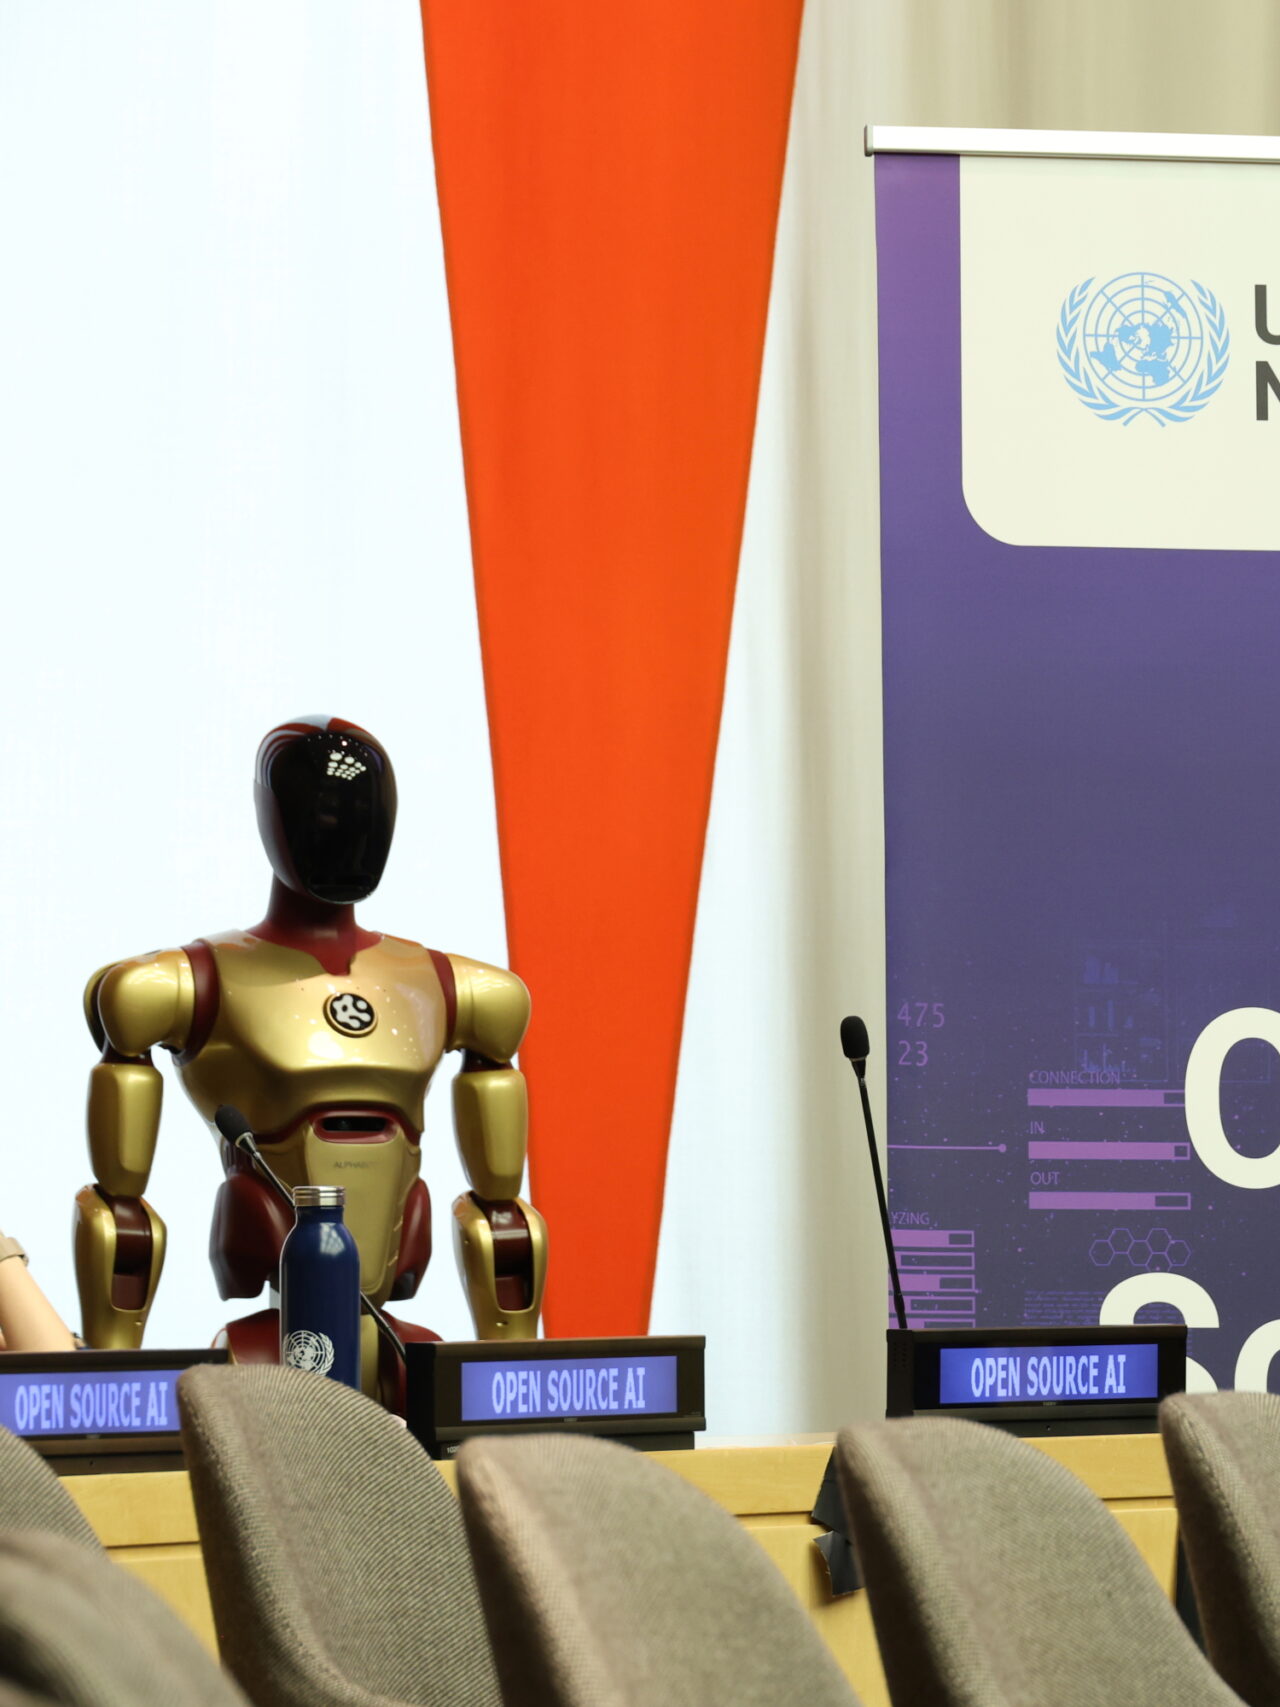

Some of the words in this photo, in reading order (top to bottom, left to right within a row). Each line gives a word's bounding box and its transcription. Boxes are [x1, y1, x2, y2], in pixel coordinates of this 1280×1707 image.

[897, 1002, 946, 1029] 475
[898, 1040, 929, 1067] 23
[1028, 1070, 1121, 1085] CONNECTION
[1029, 1121, 1045, 1135] IN
[1030, 1172, 1060, 1186] OUT
[971, 1356, 1021, 1398] OPEN
[1026, 1354, 1100, 1397] SOURCE
[1104, 1354, 1127, 1394] AI
[491, 1370, 542, 1415] OPEN
[547, 1367, 619, 1412] SOURCE
[624, 1367, 646, 1410] AI
[14, 1383, 65, 1431] OPEN
[69, 1382, 142, 1429] SOURCE
[146, 1381, 169, 1427] AI
